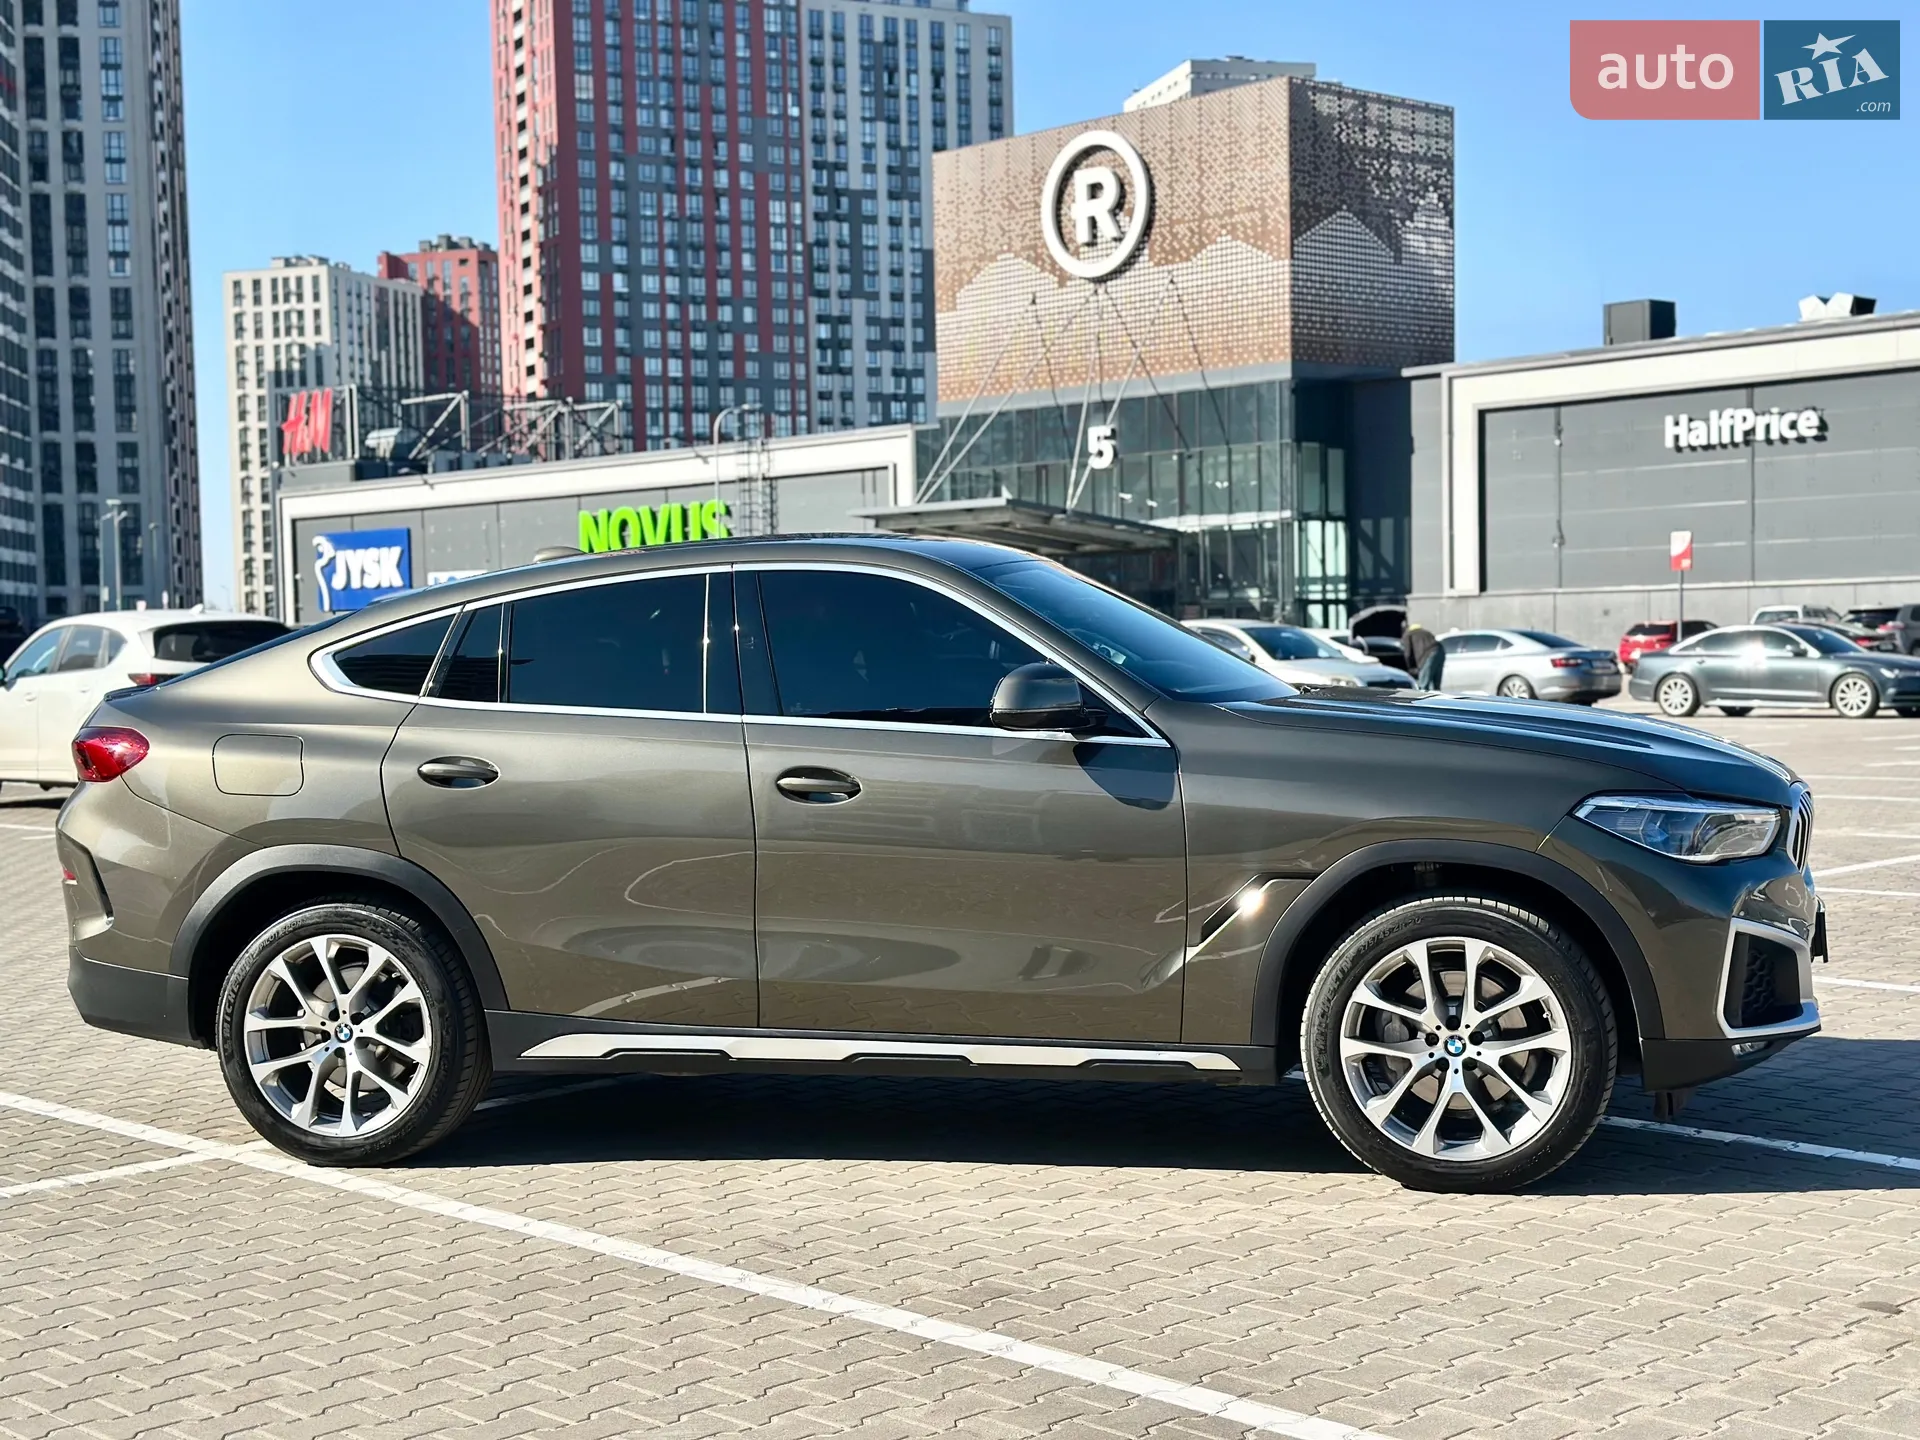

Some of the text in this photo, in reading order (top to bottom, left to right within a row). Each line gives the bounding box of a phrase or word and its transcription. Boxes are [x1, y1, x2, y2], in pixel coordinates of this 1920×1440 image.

[281, 387, 332, 454] H&M
[1664, 407, 1820, 449] HalfPrice
[1088, 425, 1114, 469] 5
[579, 499, 728, 553] NOVUS
[331, 546, 403, 590] JYSK
